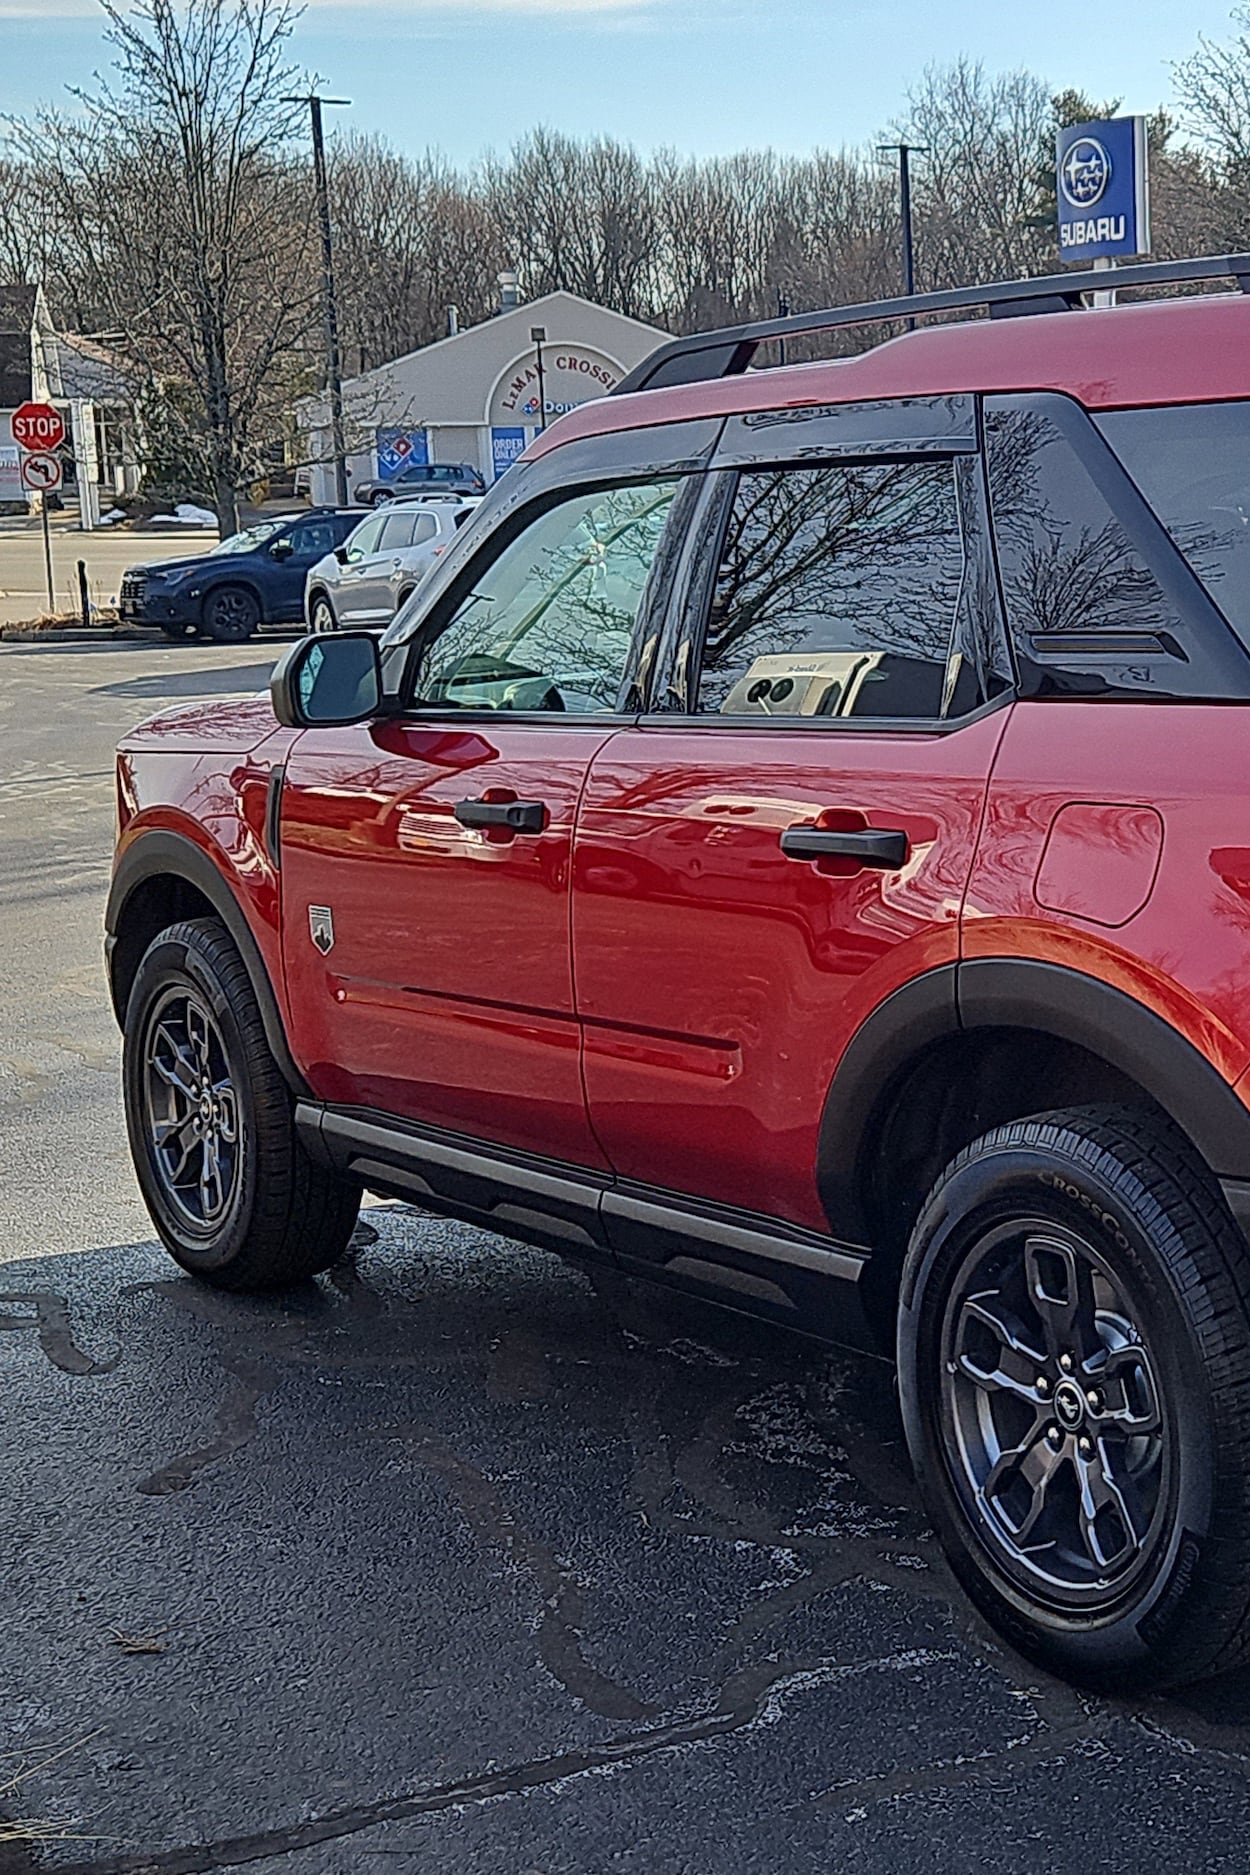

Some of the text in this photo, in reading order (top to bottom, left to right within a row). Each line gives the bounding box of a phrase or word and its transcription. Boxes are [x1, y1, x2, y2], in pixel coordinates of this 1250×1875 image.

[1060, 215, 1126, 248] SUBARU
[556, 356, 617, 390] CROSSI
[15, 417, 61, 437] STOP
[494, 438, 523, 450] ORDER
[494, 449, 520, 460] ONLIN
